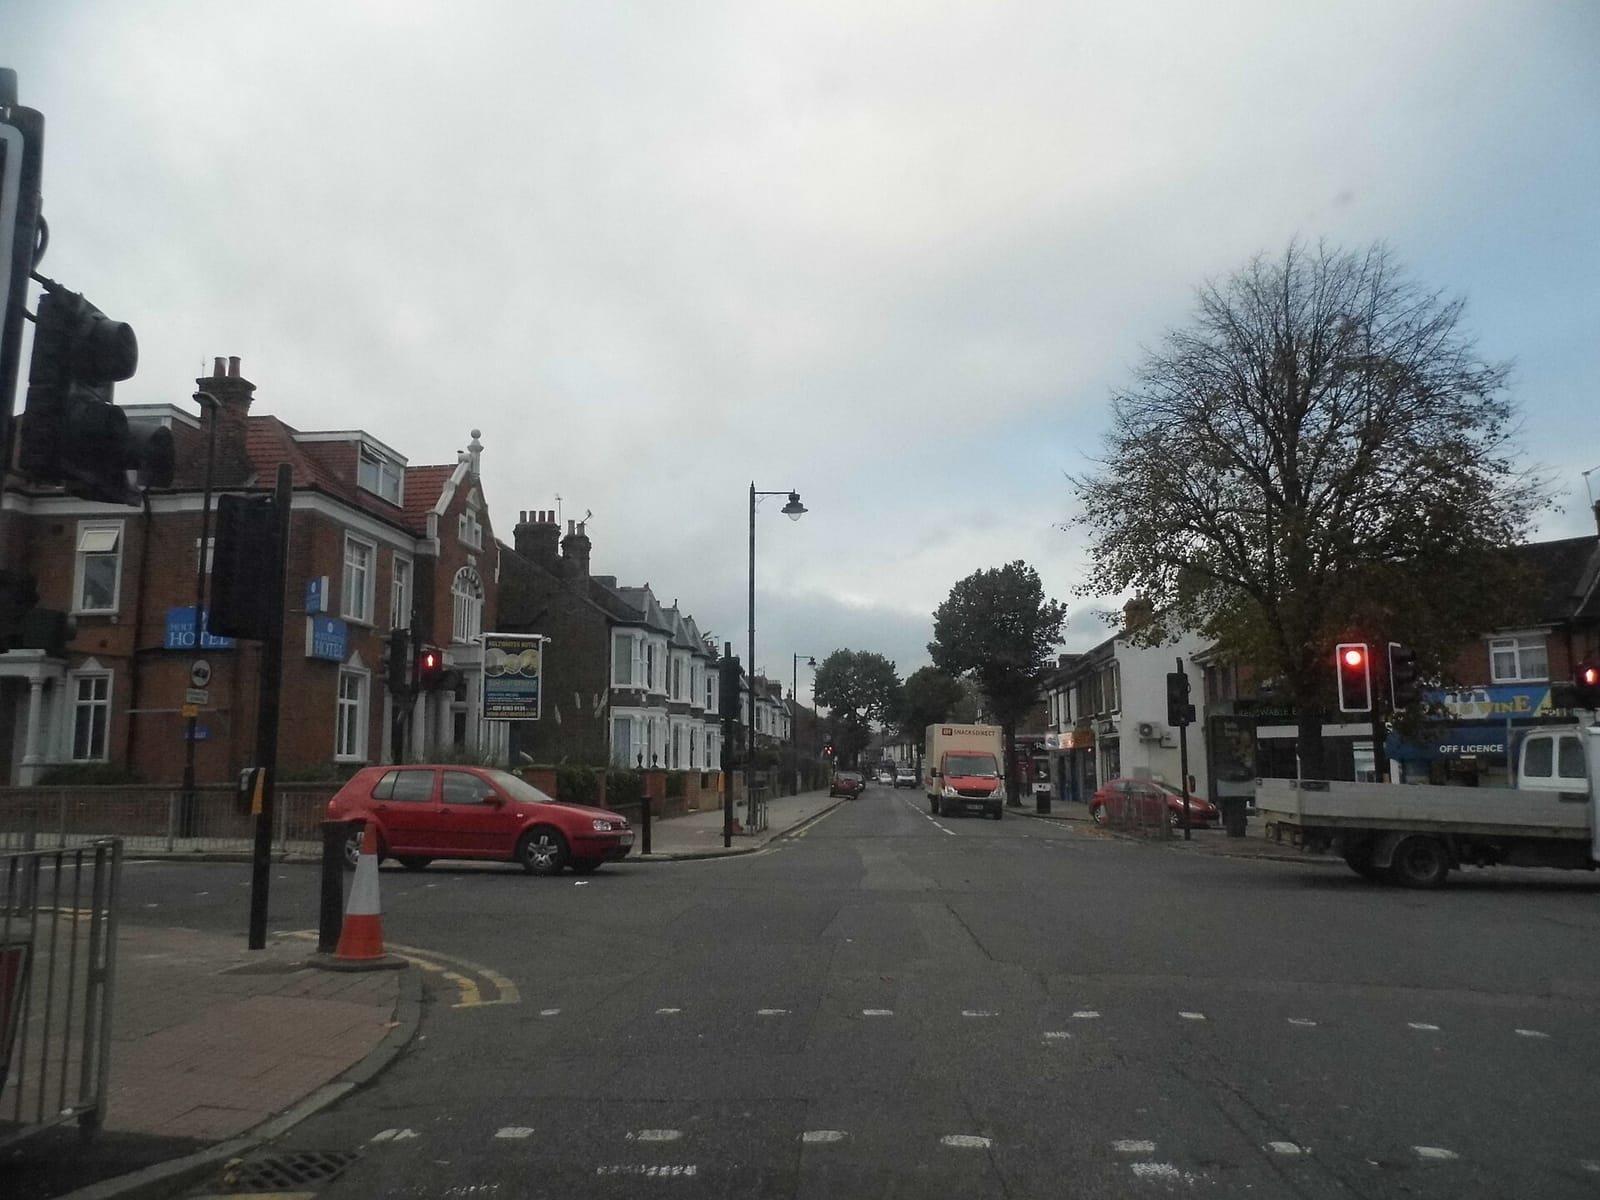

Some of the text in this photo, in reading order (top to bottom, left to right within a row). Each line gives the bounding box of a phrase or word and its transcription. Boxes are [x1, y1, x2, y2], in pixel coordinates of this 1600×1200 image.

[169, 631, 229, 647] HOTEL
[313, 639, 345, 659] HOTEL
[1479, 694, 1531, 714] WINE
[1439, 743, 1504, 753] OFF LICENCE
